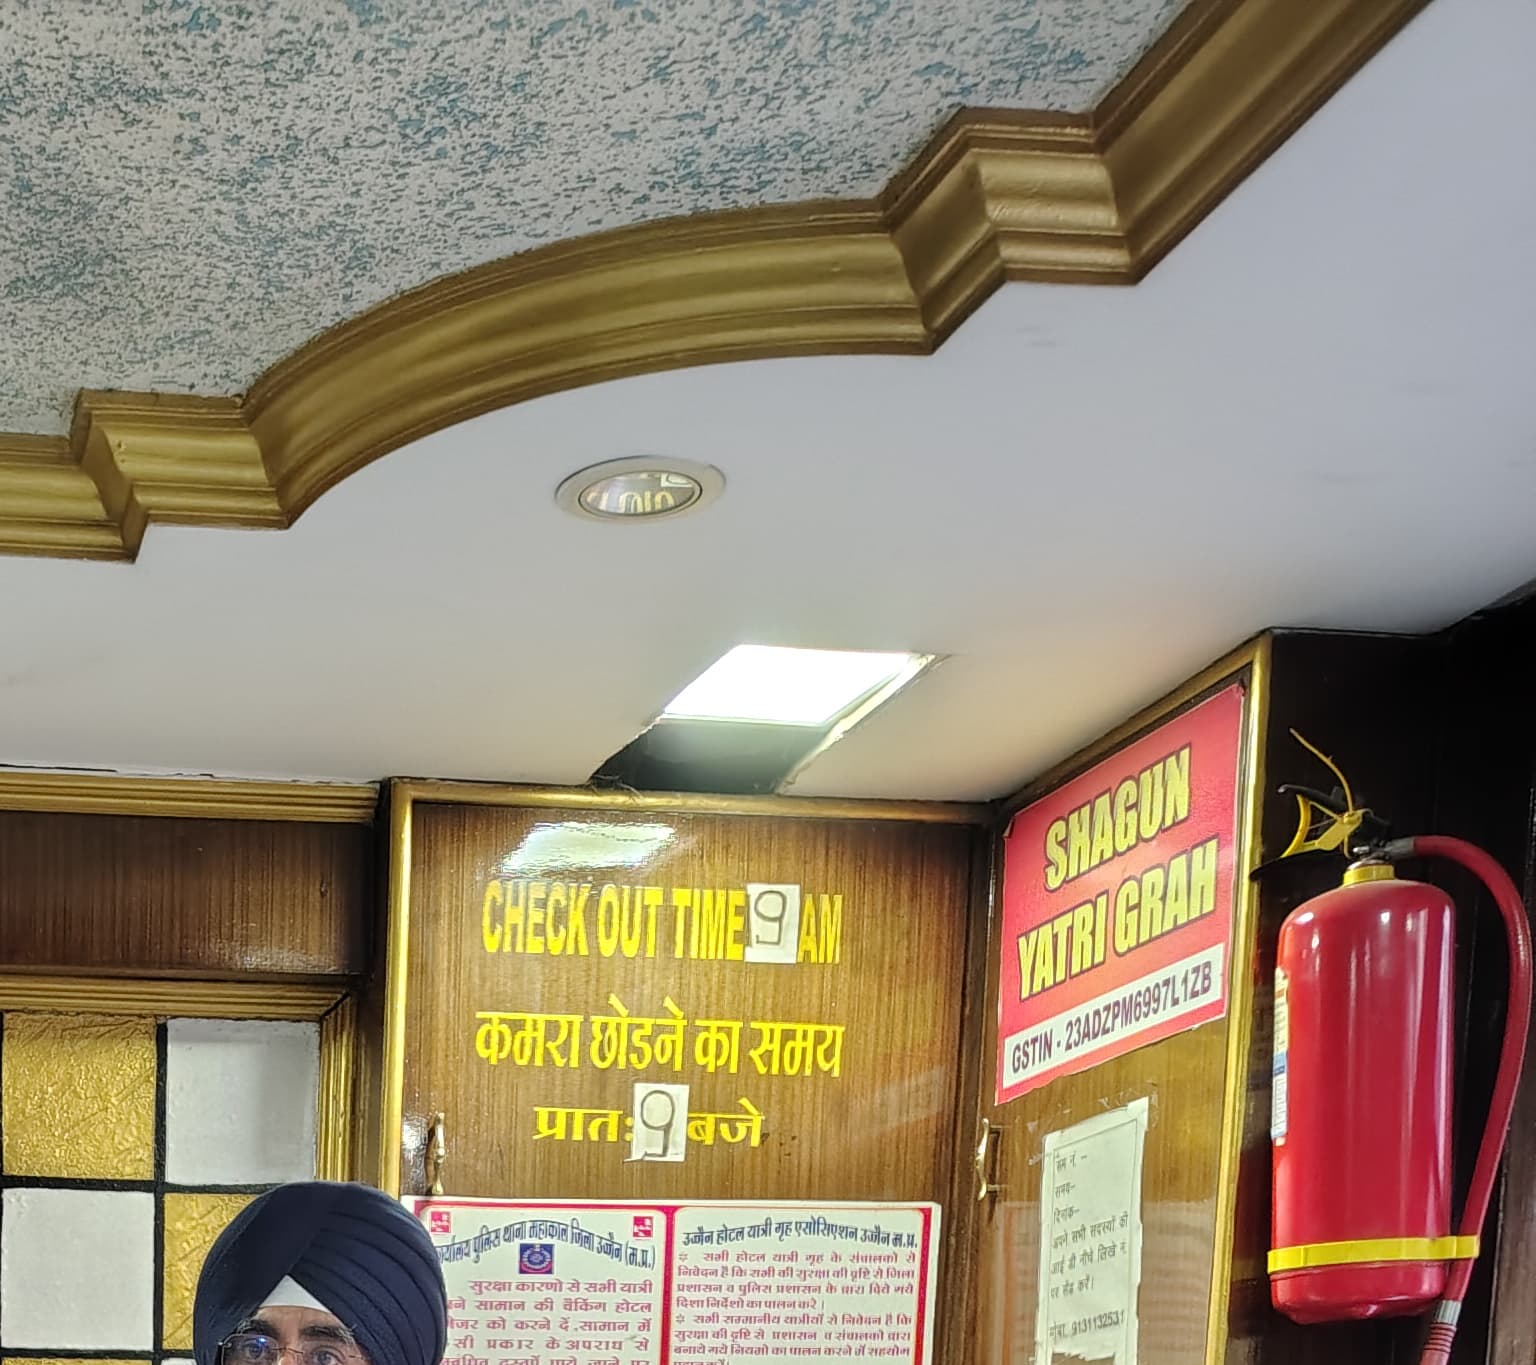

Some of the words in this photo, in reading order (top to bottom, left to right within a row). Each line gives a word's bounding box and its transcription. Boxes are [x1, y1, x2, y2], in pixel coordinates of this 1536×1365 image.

[1044, 750, 1192, 893] SHAGUN
[481, 880, 592, 956] CHECK
[597, 884, 664, 958] OUT
[672, 887, 746, 961] TIME
[754, 890, 787, 946] 9
[797, 894, 843, 964] AM
[1017, 893, 1108, 1002] YATRI
[1113, 836, 1219, 957] GRAH
[1011, 1027, 1054, 1074] GSTIN
[1064, 961, 1212, 1052] 23ADZPM6997L1ZB
[475, 1011, 583, 1069] कमरा
[590, 993, 687, 1071] छोडने
[695, 1019, 742, 1074] का
[751, 1021, 845, 1078] समय
[640, 1090, 675, 1157] 9
[686, 1097, 764, 1147] बजे
[472, 1225, 501, 1264] पुलिस
[503, 1221, 526, 1242] थाना
[528, 1219, 568, 1242] महाकाल
[571, 1218, 594, 1251] जिला
[682, 1227, 714, 1247] उज्जैन
[716, 1224, 744, 1246] होटल
[747, 1217, 772, 1239] यात्री
[775, 1221, 792, 1242] गृह
[795, 1216, 858, 1241] एसोसिएशन
[860, 1225, 889, 1245] उज्जैन
[704, 1250, 729, 1262] सभी
[735, 1252, 765, 1263] होटल
[772, 1250, 798, 1263] यात्री
[469, 1280, 511, 1295] सुरक्षा
[567, 1280, 580, 1293] से
[584, 1279, 616, 1293] सभी
[620, 1280, 653, 1294] यात्री
[475, 1299, 525, 1311] सामान
[534, 1297, 554, 1312] की
[615, 1299, 652, 1313] होटल
[693, 1312, 719, 1324] सभी
[764, 1299, 796, 1309] पालन
[486, 1316, 506, 1331] को
[514, 1316, 551, 1331] करने
[637, 1318, 652, 1332] में
[487, 1338, 533, 1349] प्रकार
[546, 1337, 560, 1349] के
[566, 1339, 623, 1351] अपराध
[635, 1338, 649, 1352] से
